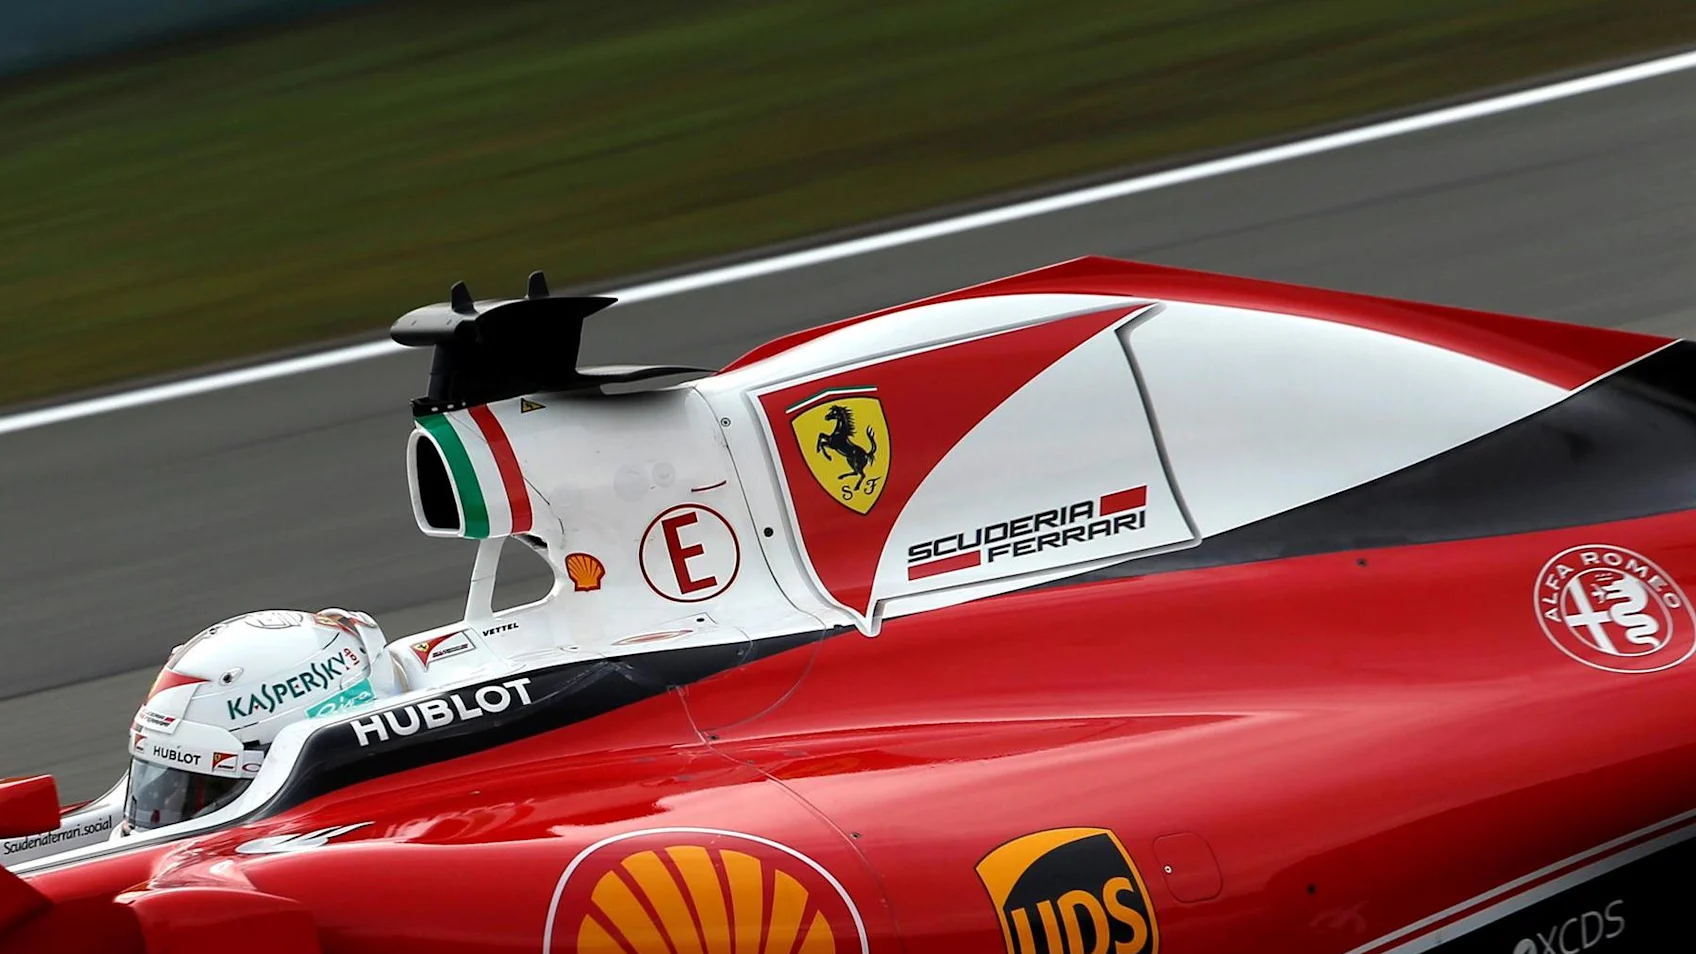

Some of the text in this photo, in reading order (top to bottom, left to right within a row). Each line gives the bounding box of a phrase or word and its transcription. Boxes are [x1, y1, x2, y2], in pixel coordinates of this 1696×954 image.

[660, 511, 718, 595] E
[907, 500, 1094, 563] SCUDERIA
[988, 510, 1146, 563] FERRARI
[1541, 551, 1683, 623] ALFA ROMEO
[482, 622, 520, 637] VETTEL
[227, 651, 346, 720] KASPERSKY
[350, 677, 532, 747] HUBLOT
[153, 745, 202, 766] HUBLOT
